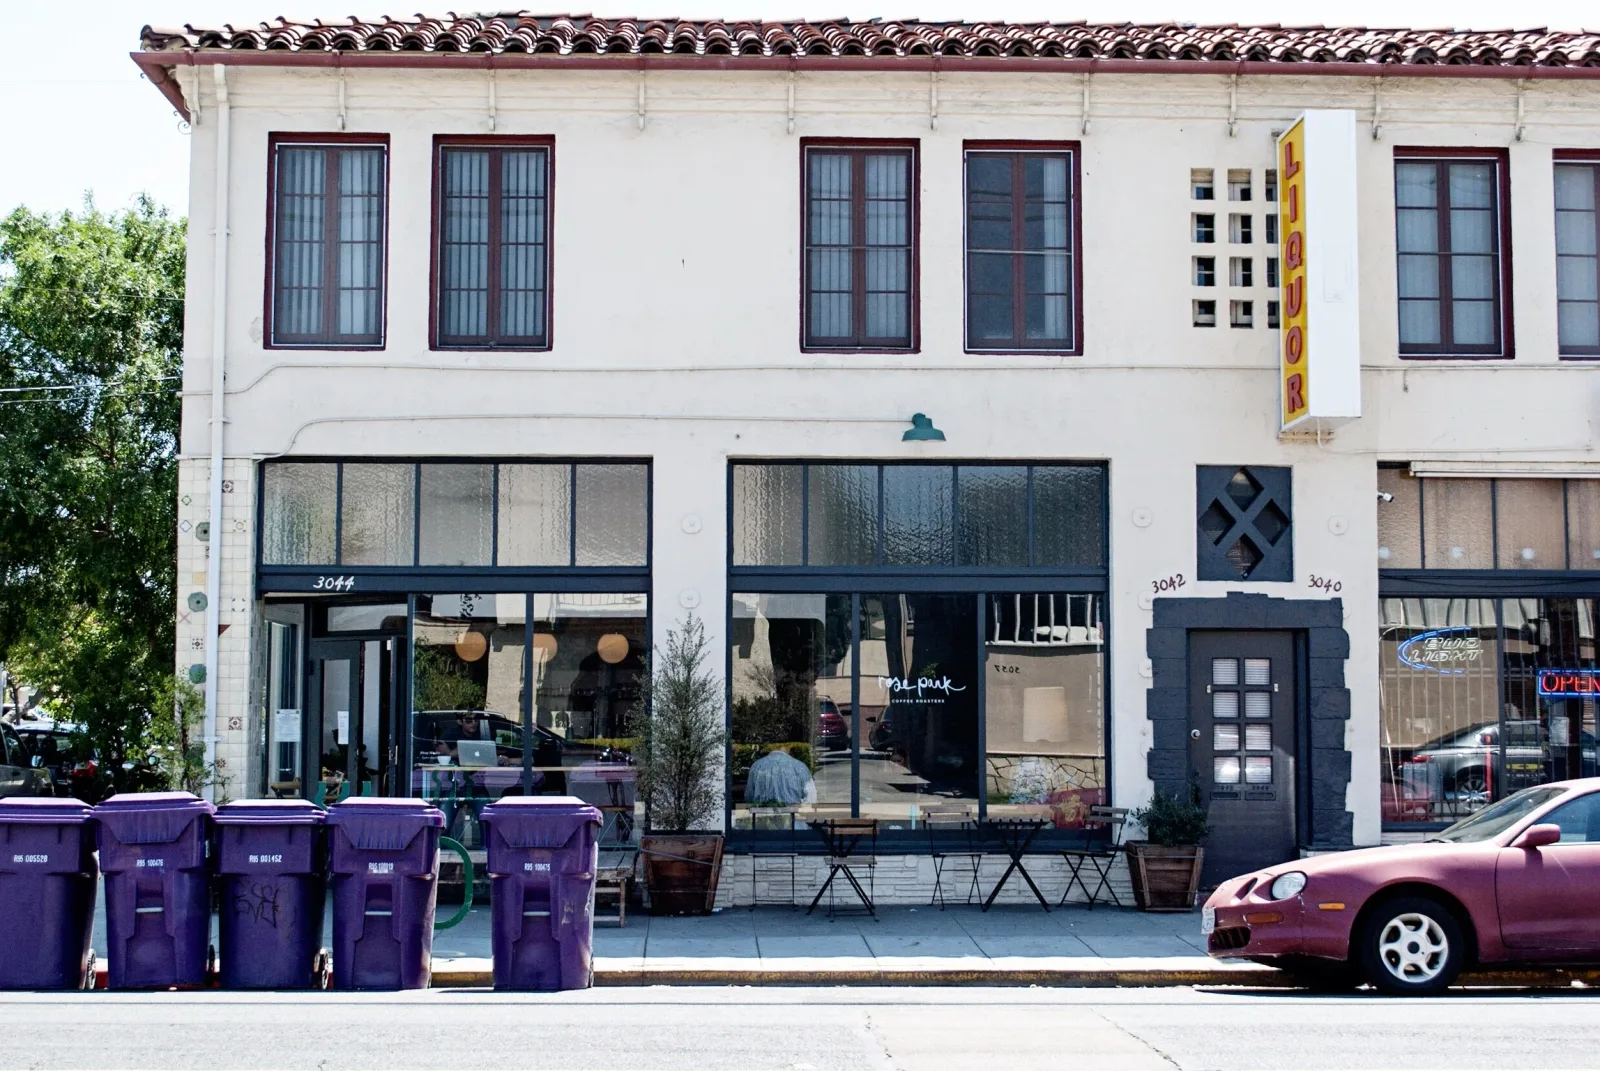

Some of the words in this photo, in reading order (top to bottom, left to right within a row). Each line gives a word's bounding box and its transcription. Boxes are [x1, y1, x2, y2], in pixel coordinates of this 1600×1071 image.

[1284, 141, 1304, 414] LIQUOR
[312, 575, 355, 592] 3044
[1151, 573, 1186, 594] 3042
[1307, 574, 1342, 594] 3040
[877, 675, 917, 692] rose
[917, 675, 967, 698] park
[1542, 672, 1600, 692] OPEN
